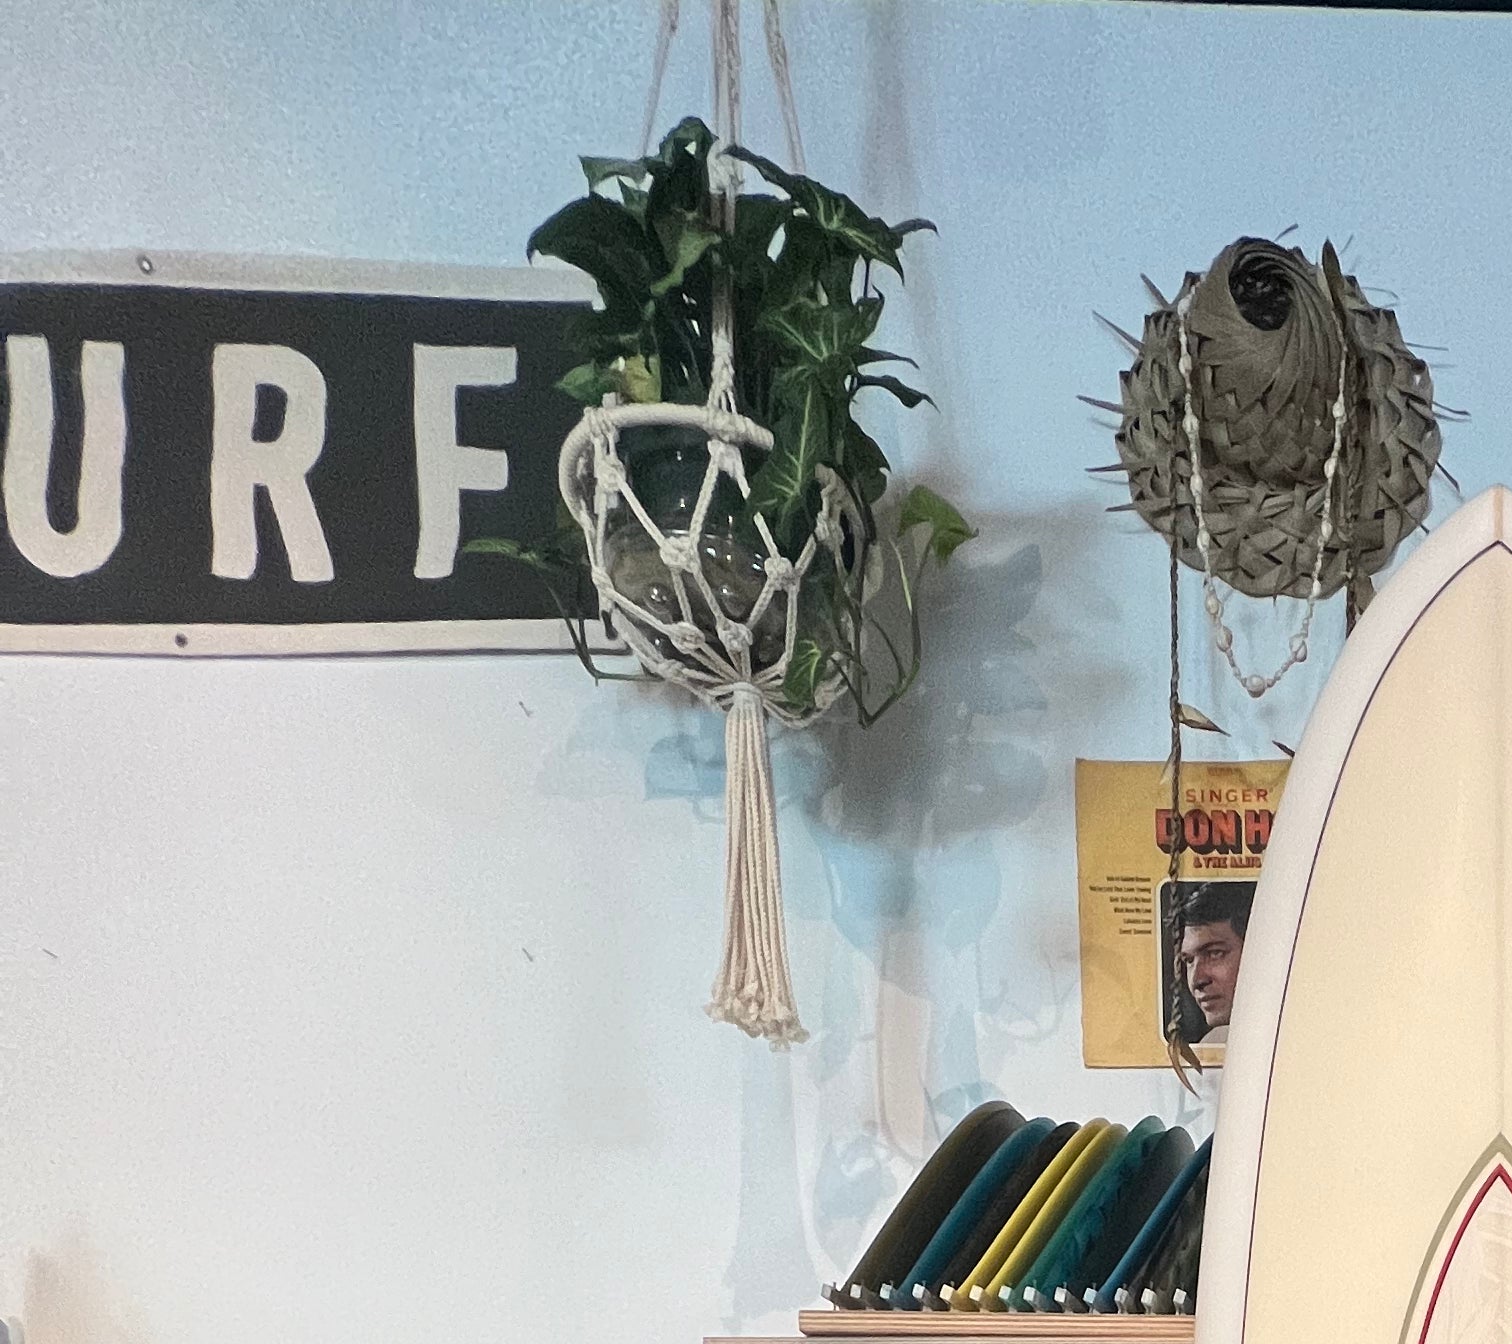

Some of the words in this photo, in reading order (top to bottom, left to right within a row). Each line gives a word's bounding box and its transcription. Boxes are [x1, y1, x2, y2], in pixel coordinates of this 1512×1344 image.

[3, 333, 517, 583] URF
[1185, 788, 1269, 803] SINGER
[1244, 809, 1277, 855] H
